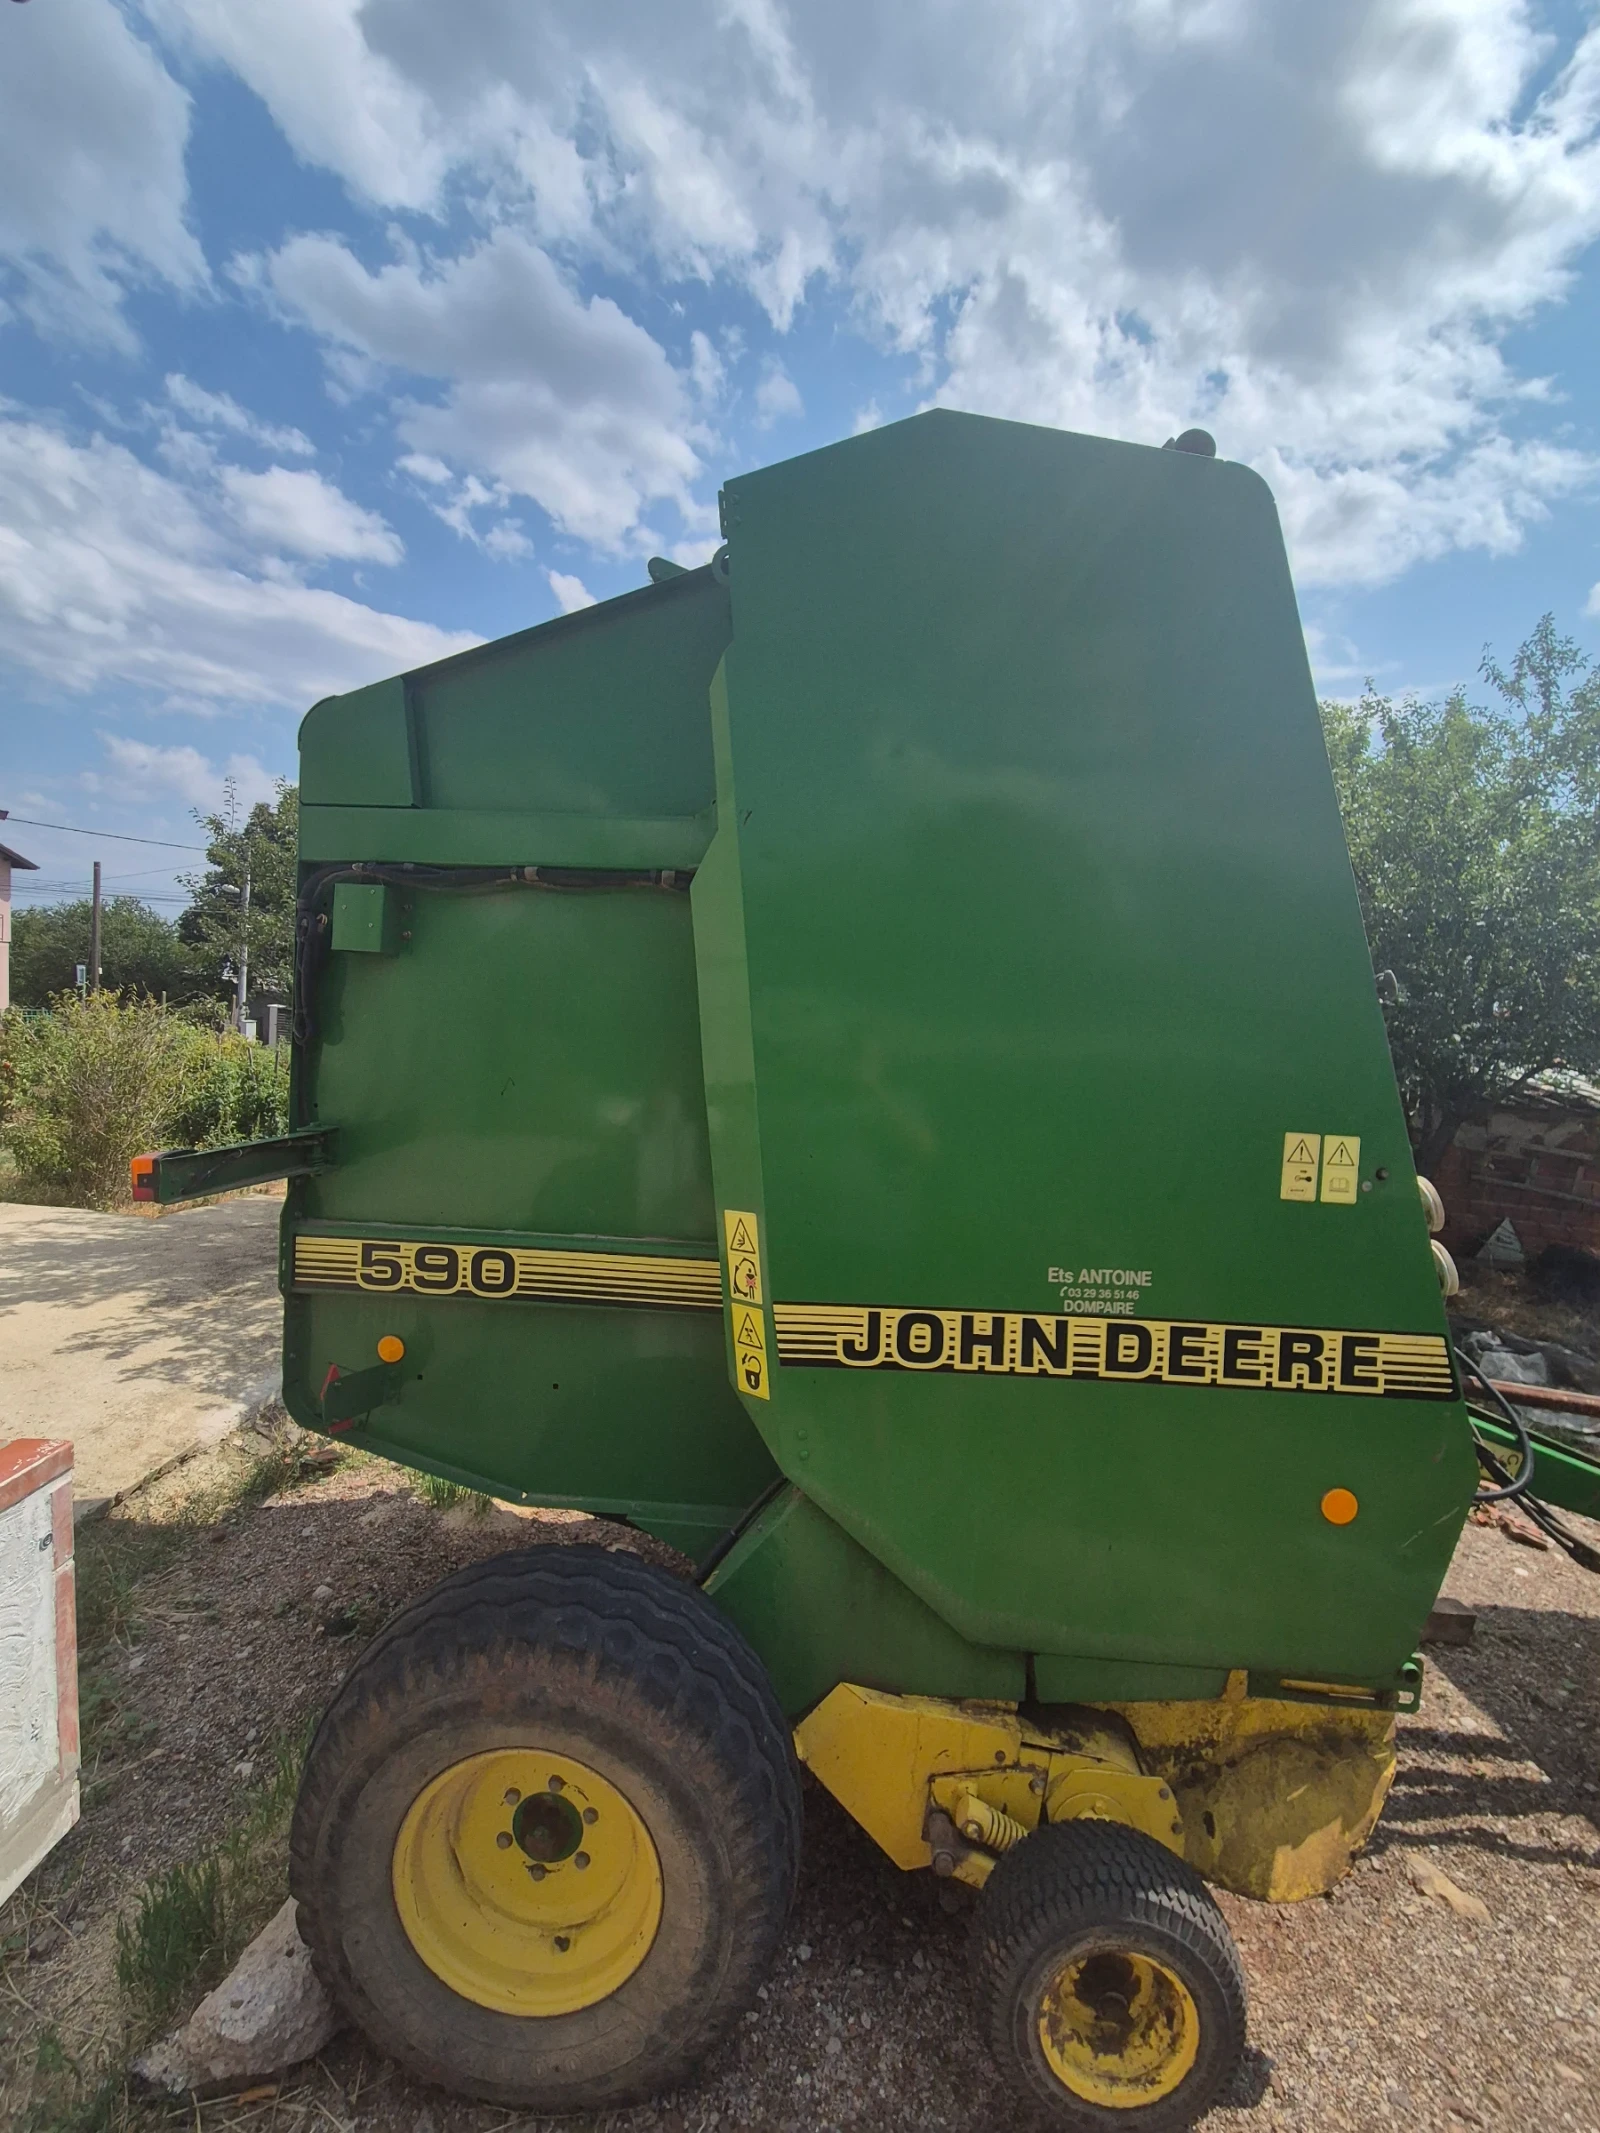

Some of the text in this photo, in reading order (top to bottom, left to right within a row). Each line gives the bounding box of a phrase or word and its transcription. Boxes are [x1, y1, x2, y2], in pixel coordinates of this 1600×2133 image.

[357, 1243, 519, 1298] 590
[1048, 1267, 1153, 1287] Ets ANTOINE
[1067, 1288, 1081, 1298] 03
[1083, 1288, 1097, 1299] 29
[1063, 1300, 1135, 1315] DOMPAIRE
[837, 1309, 1384, 1394] JOHN DEERE
